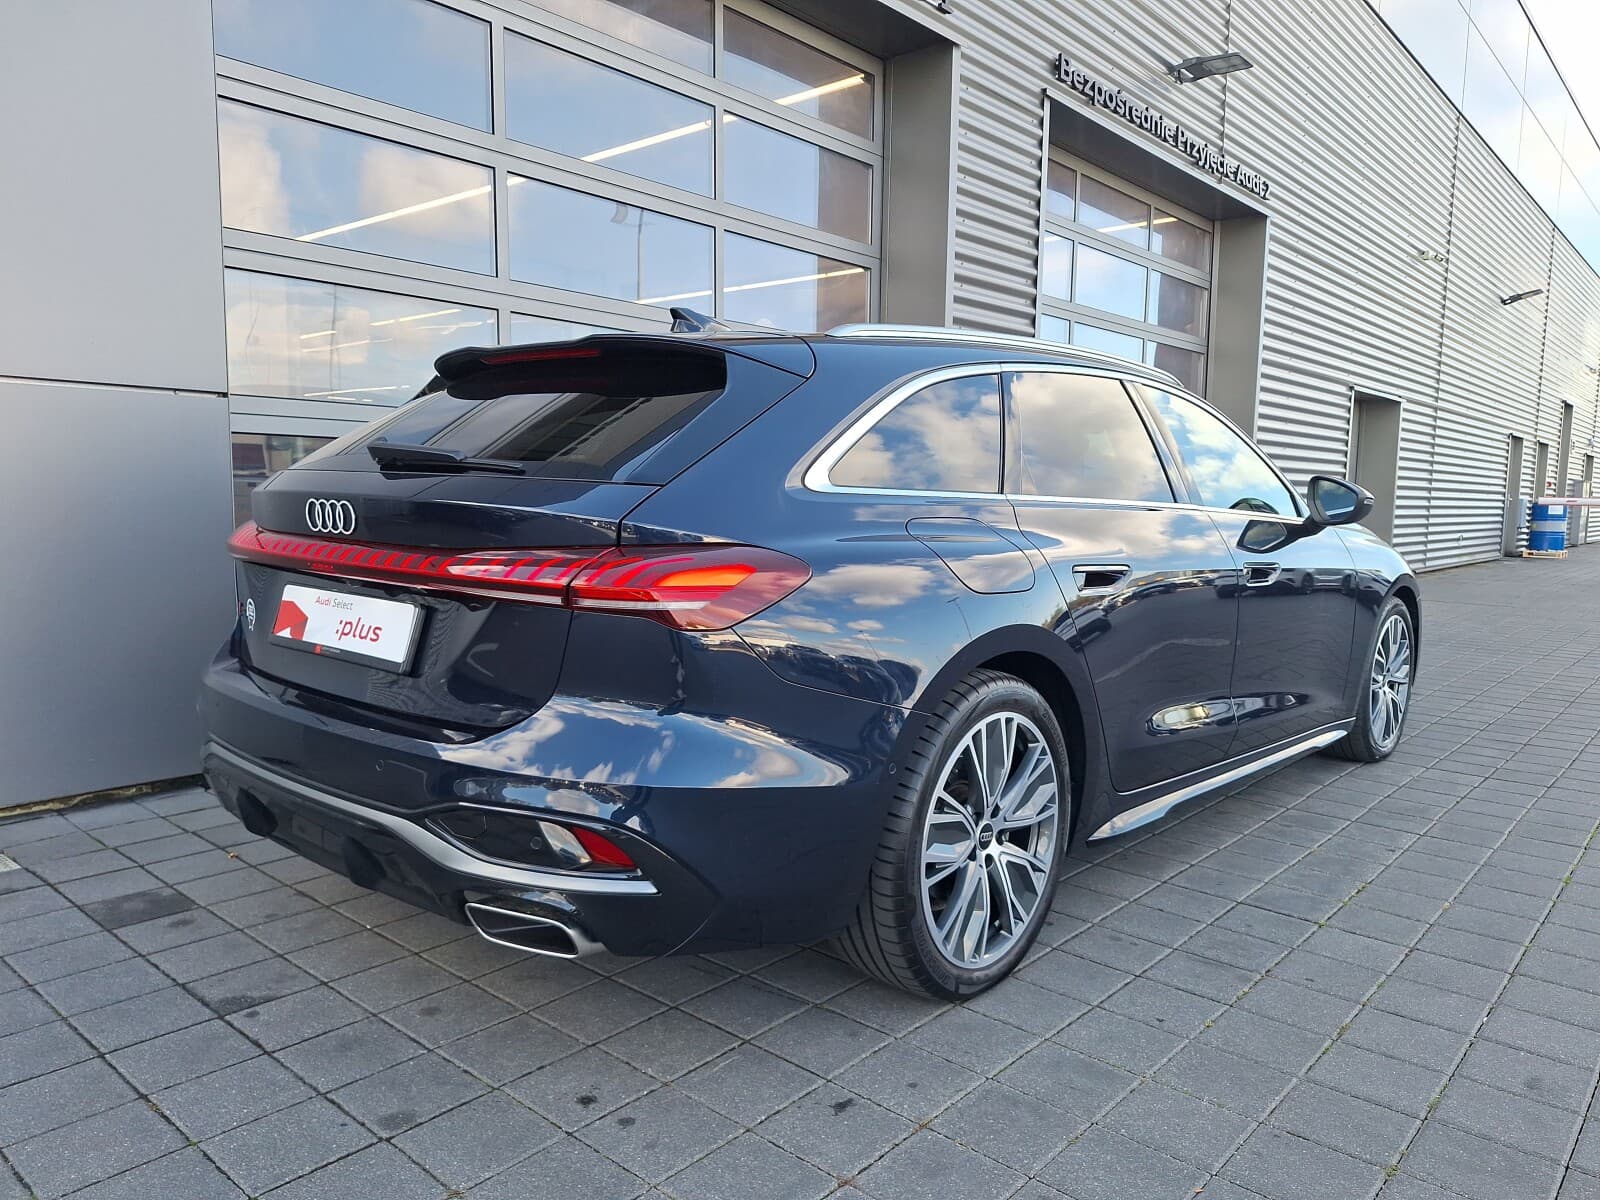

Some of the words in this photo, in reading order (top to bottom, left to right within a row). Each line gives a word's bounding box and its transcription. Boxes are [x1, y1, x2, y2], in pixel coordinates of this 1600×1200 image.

[1056, 53, 1178, 146] Bezpośrednie
[1176, 124, 1238, 177] Przyjęcie
[1237, 163, 1263, 196] Audi
[314, 596, 332, 607] Audi
[331, 597, 354, 611] Select
[335, 617, 383, 643] :plus
